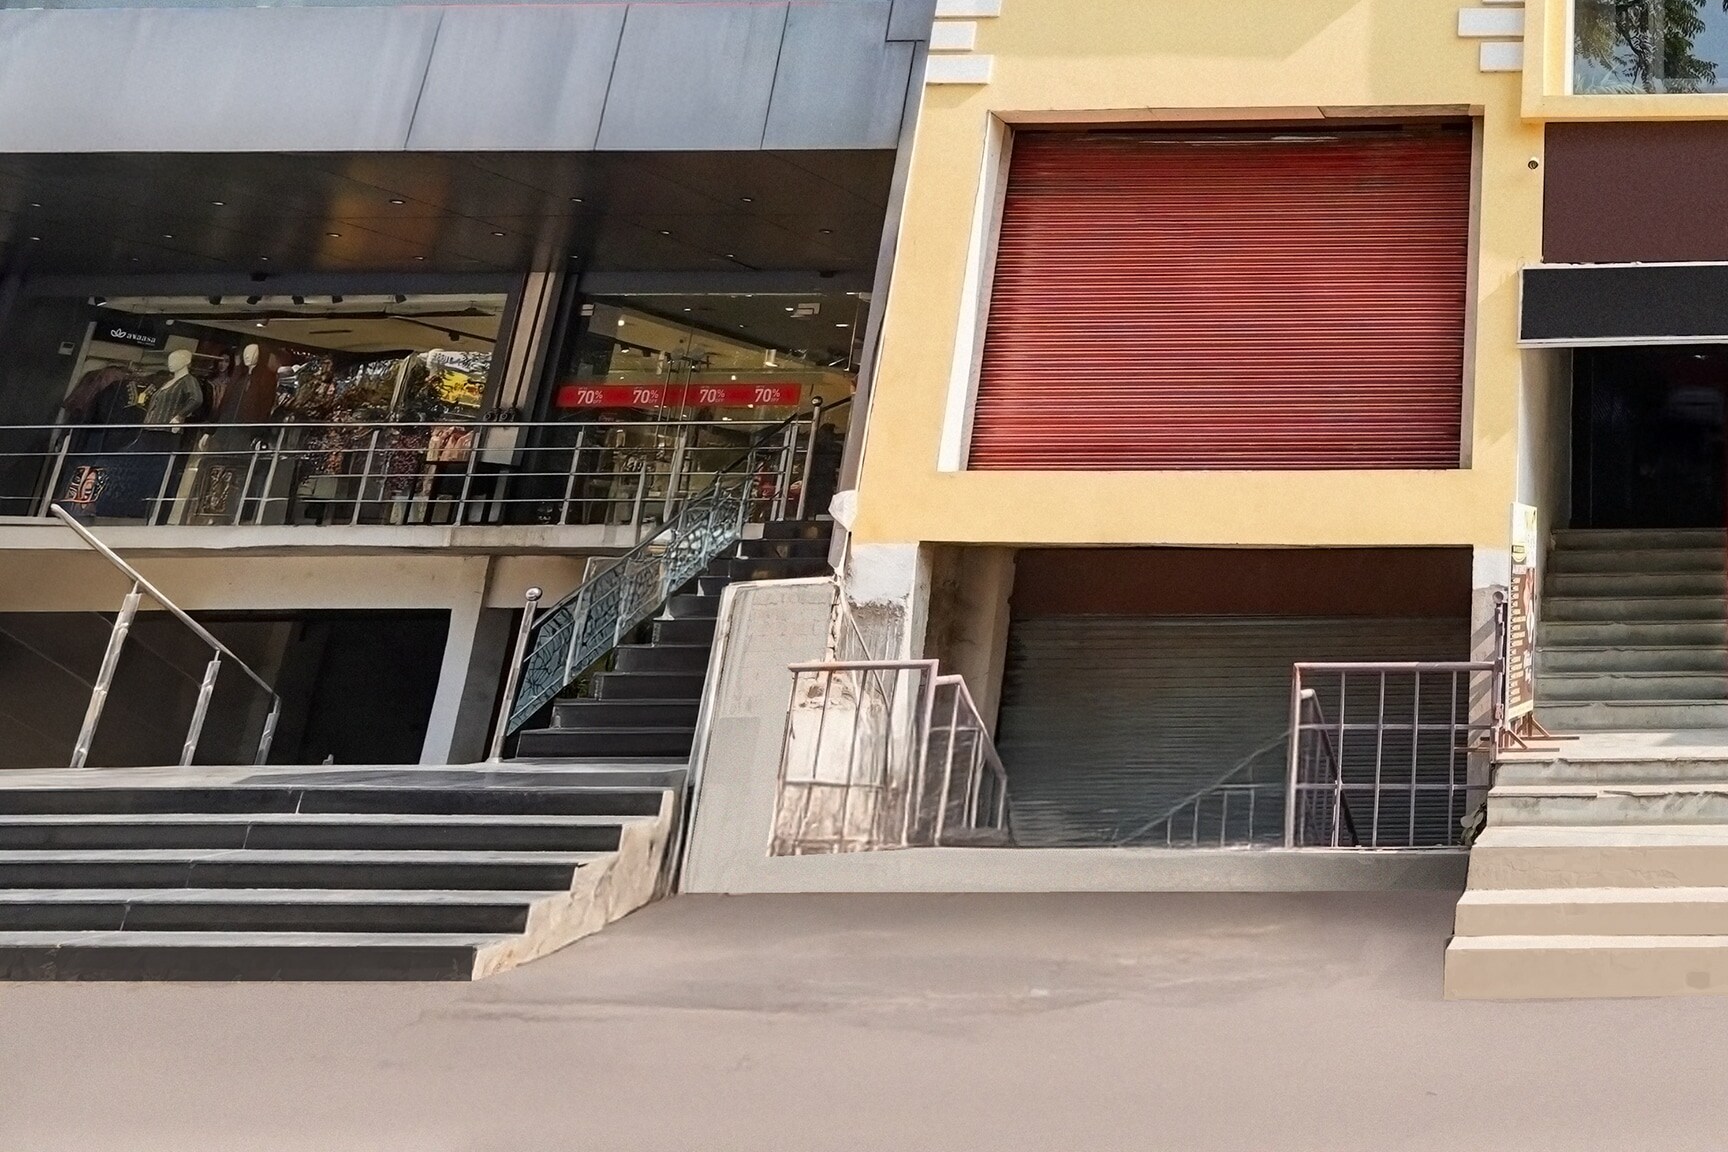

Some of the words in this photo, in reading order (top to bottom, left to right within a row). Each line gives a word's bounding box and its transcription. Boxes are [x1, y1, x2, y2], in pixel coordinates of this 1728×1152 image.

[577, 390, 603, 405] 70%
[633, 389, 659, 404] 70%
[699, 389, 726, 403] 70%
[754, 388, 781, 402] 70%
